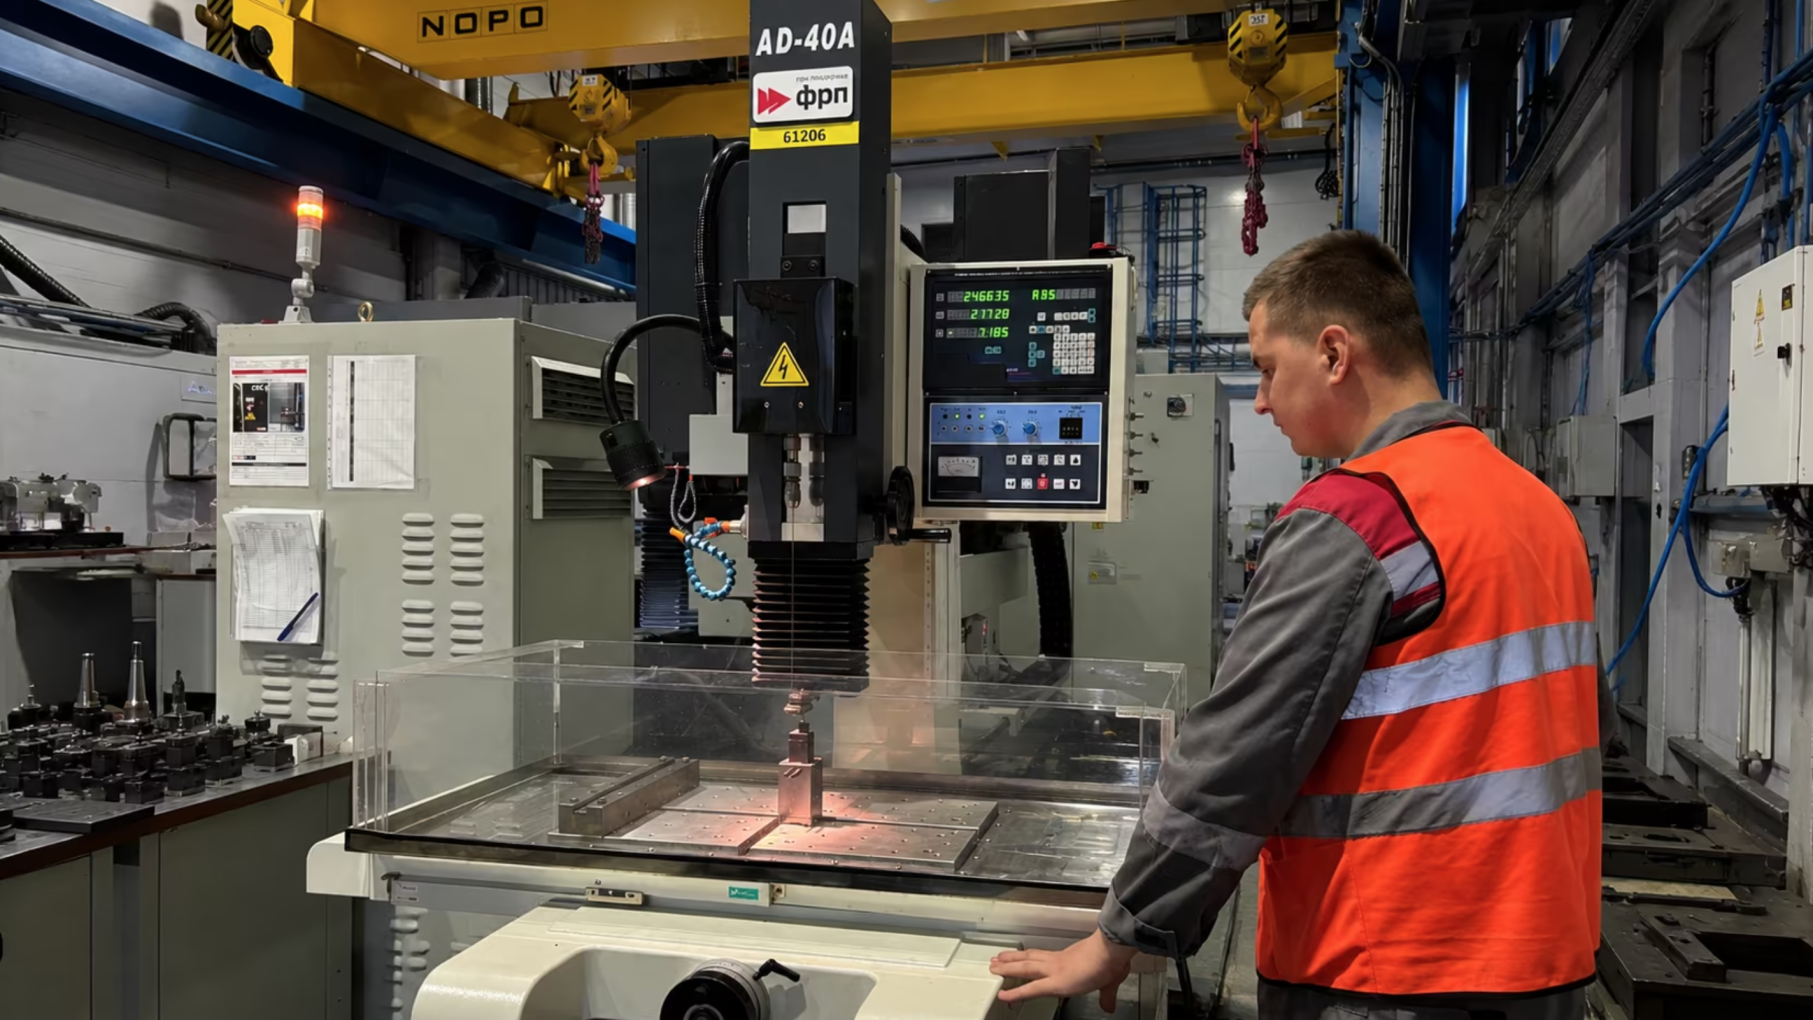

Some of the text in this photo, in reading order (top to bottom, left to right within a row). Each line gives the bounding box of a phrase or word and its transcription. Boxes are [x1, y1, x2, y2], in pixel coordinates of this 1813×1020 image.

[421, 5, 544, 38] NOPO
[755, 21, 855, 56] AD-40A
[796, 84, 848, 111] фрп
[783, 129, 827, 143] 61206
[1032, 289, 1056, 300] ABS
